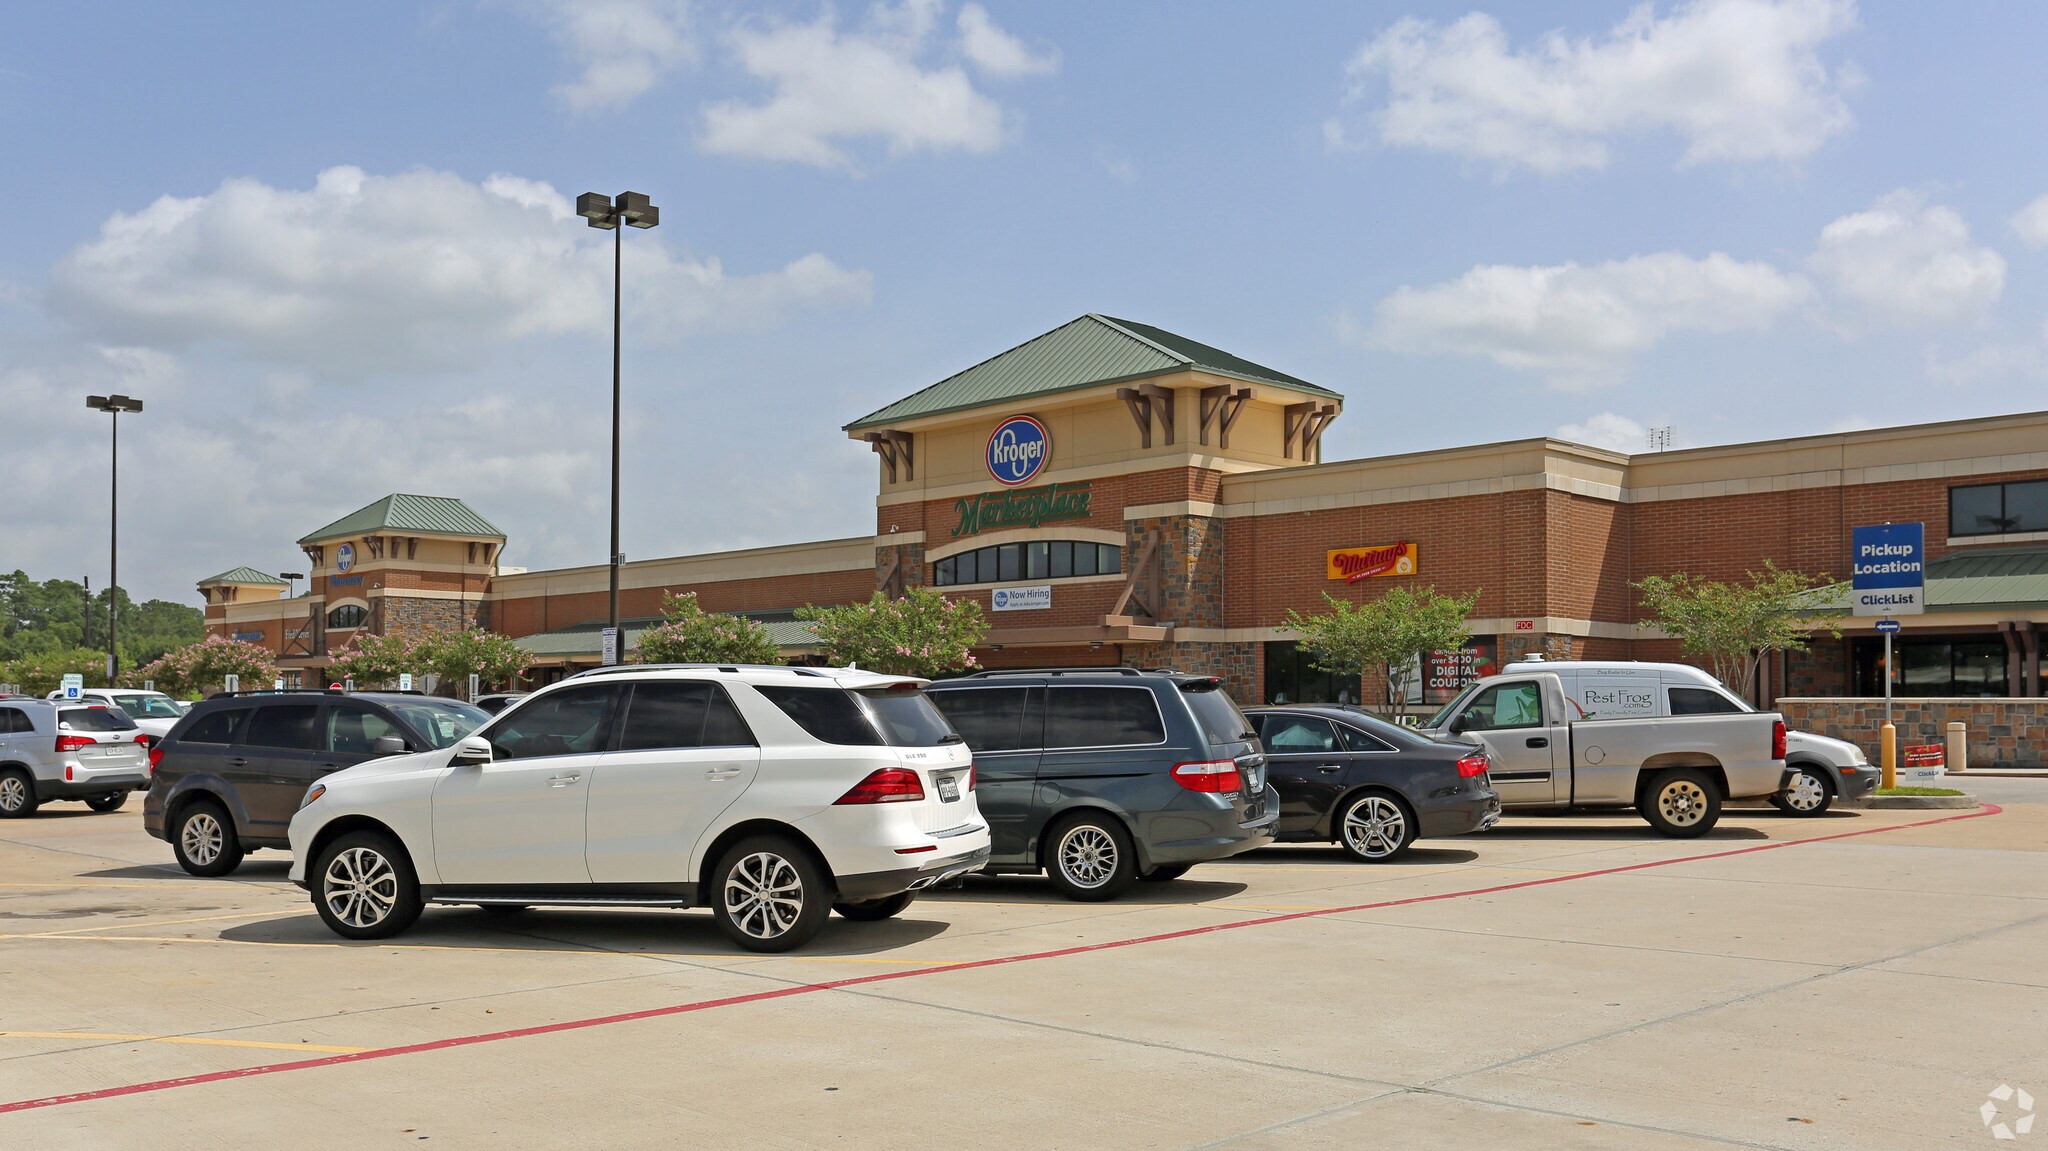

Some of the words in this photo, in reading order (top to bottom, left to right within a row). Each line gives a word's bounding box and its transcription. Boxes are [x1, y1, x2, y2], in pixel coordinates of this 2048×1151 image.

[993, 429, 1043, 477] Kroger
[951, 483, 1092, 537] Marketplace
[1861, 544, 1914, 557] Pickup
[1333, 541, 1408, 576] Murray's
[1854, 561, 1921, 575] Location
[1010, 591, 1026, 600] Now
[1027, 589, 1050, 600] Hiring
[1861, 594, 1914, 605] ClickList
[1516, 621, 1532, 629] FDC
[1448, 655, 1471, 665] $400
[1473, 656, 1480, 664] in
[1436, 665, 1479, 676] DIGITAL
[1585, 690, 1616, 705] Pest
[1618, 690, 1653, 708] Frog
